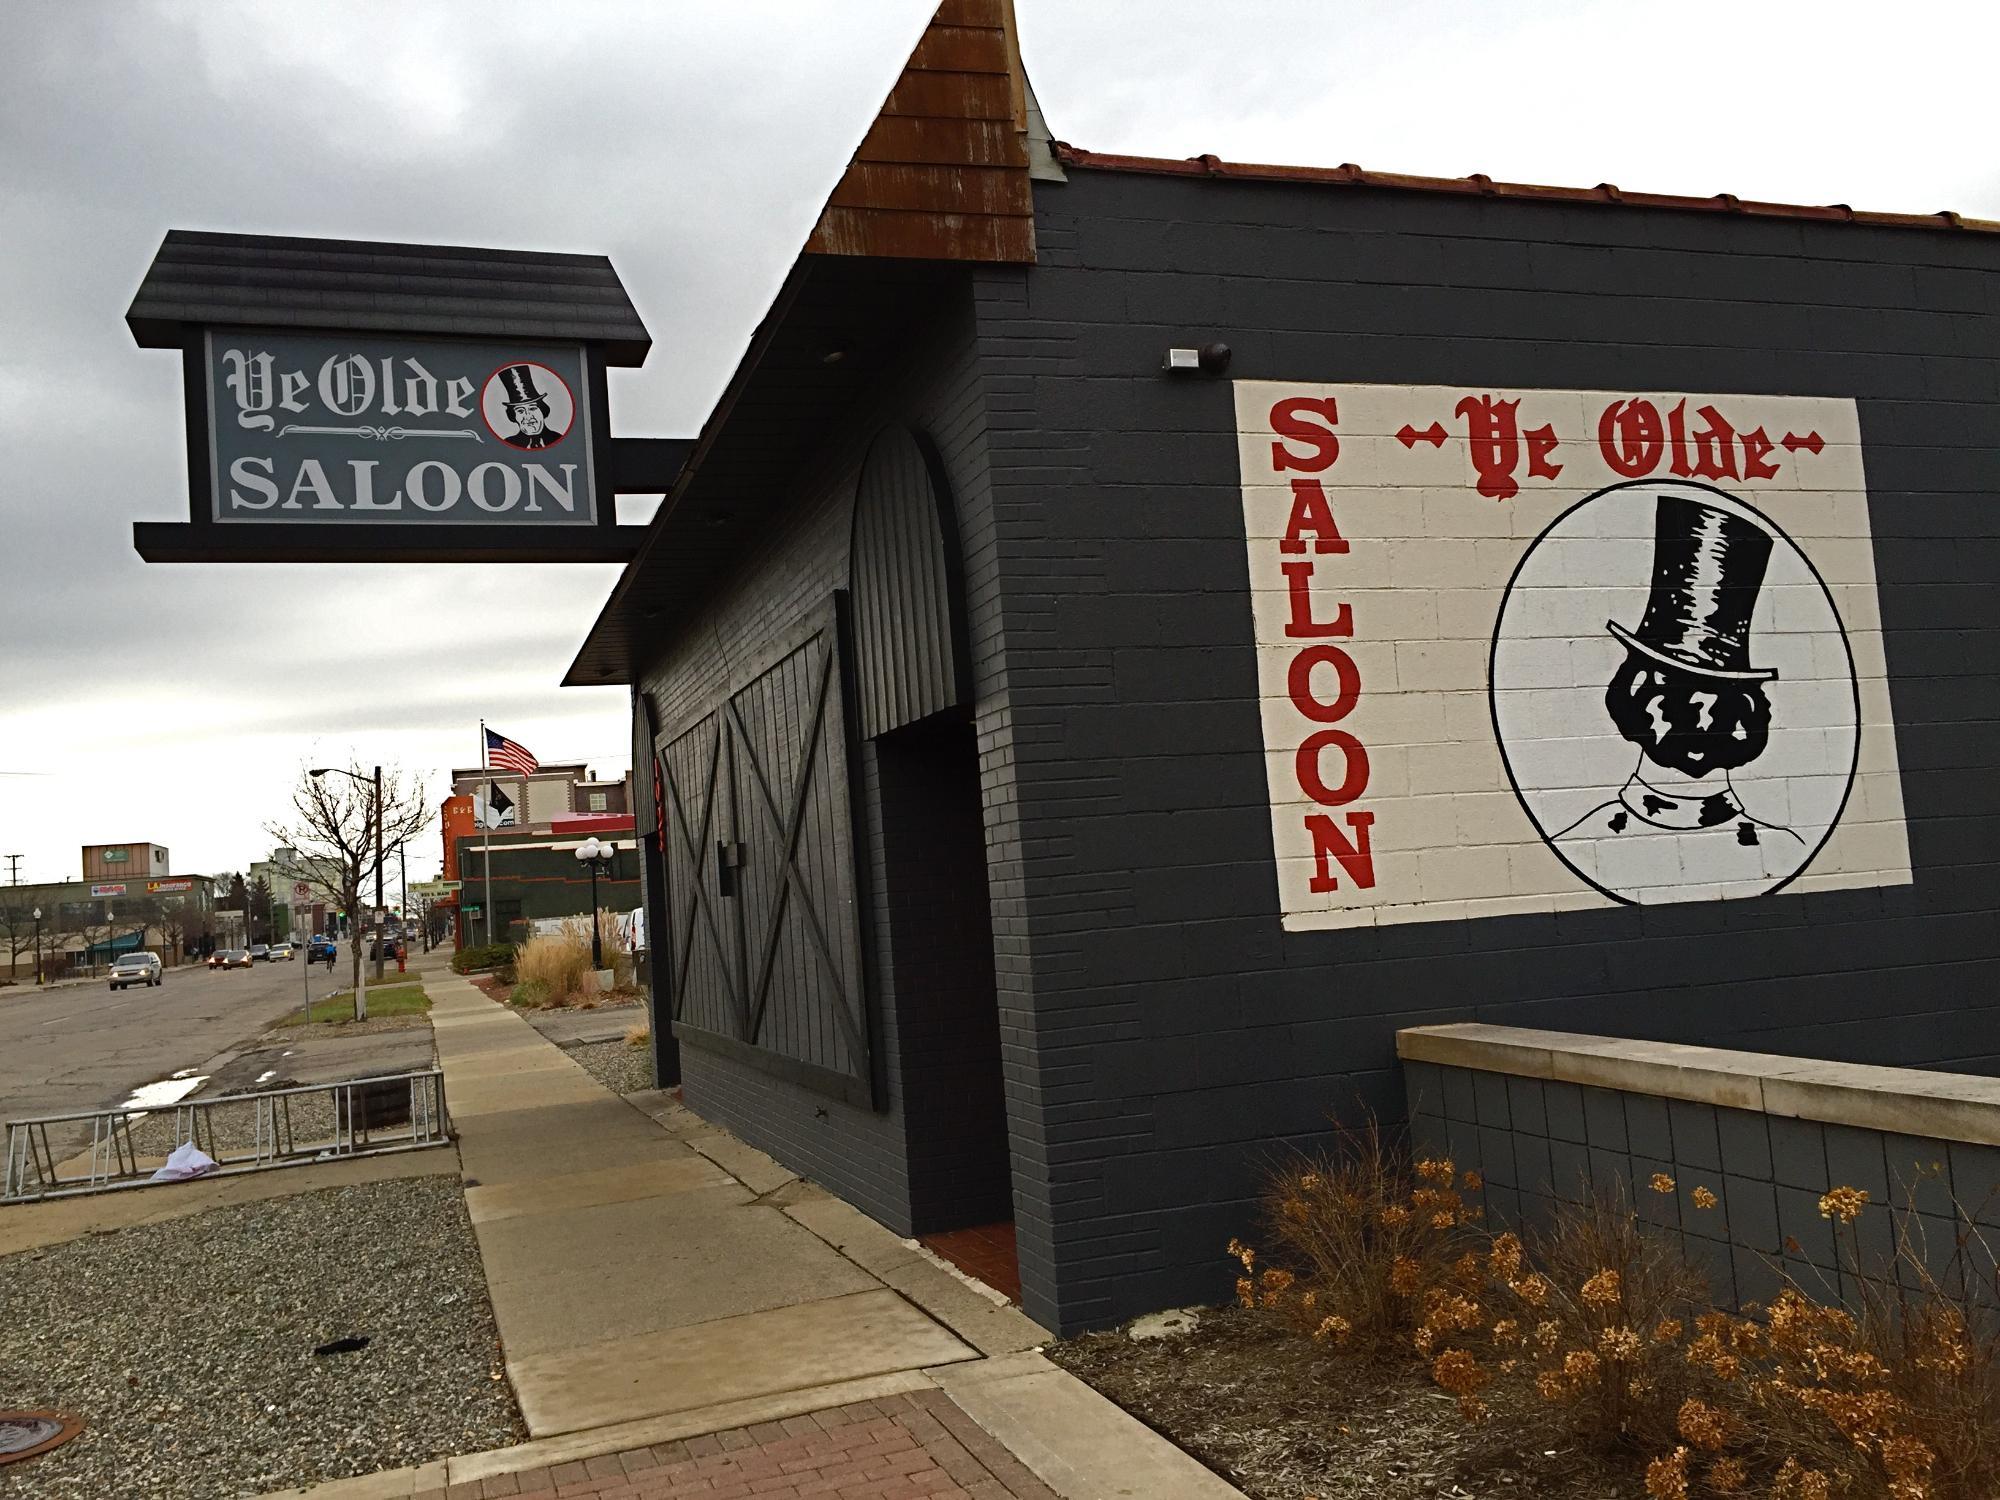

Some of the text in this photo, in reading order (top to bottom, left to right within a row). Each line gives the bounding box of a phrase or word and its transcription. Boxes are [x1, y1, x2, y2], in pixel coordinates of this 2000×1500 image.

[222, 349, 476, 432] Ye Olde
[229, 456, 578, 513] SALOON
[1455, 394, 1782, 502] Ye Olde
[1269, 397, 1376, 894] SALOON
